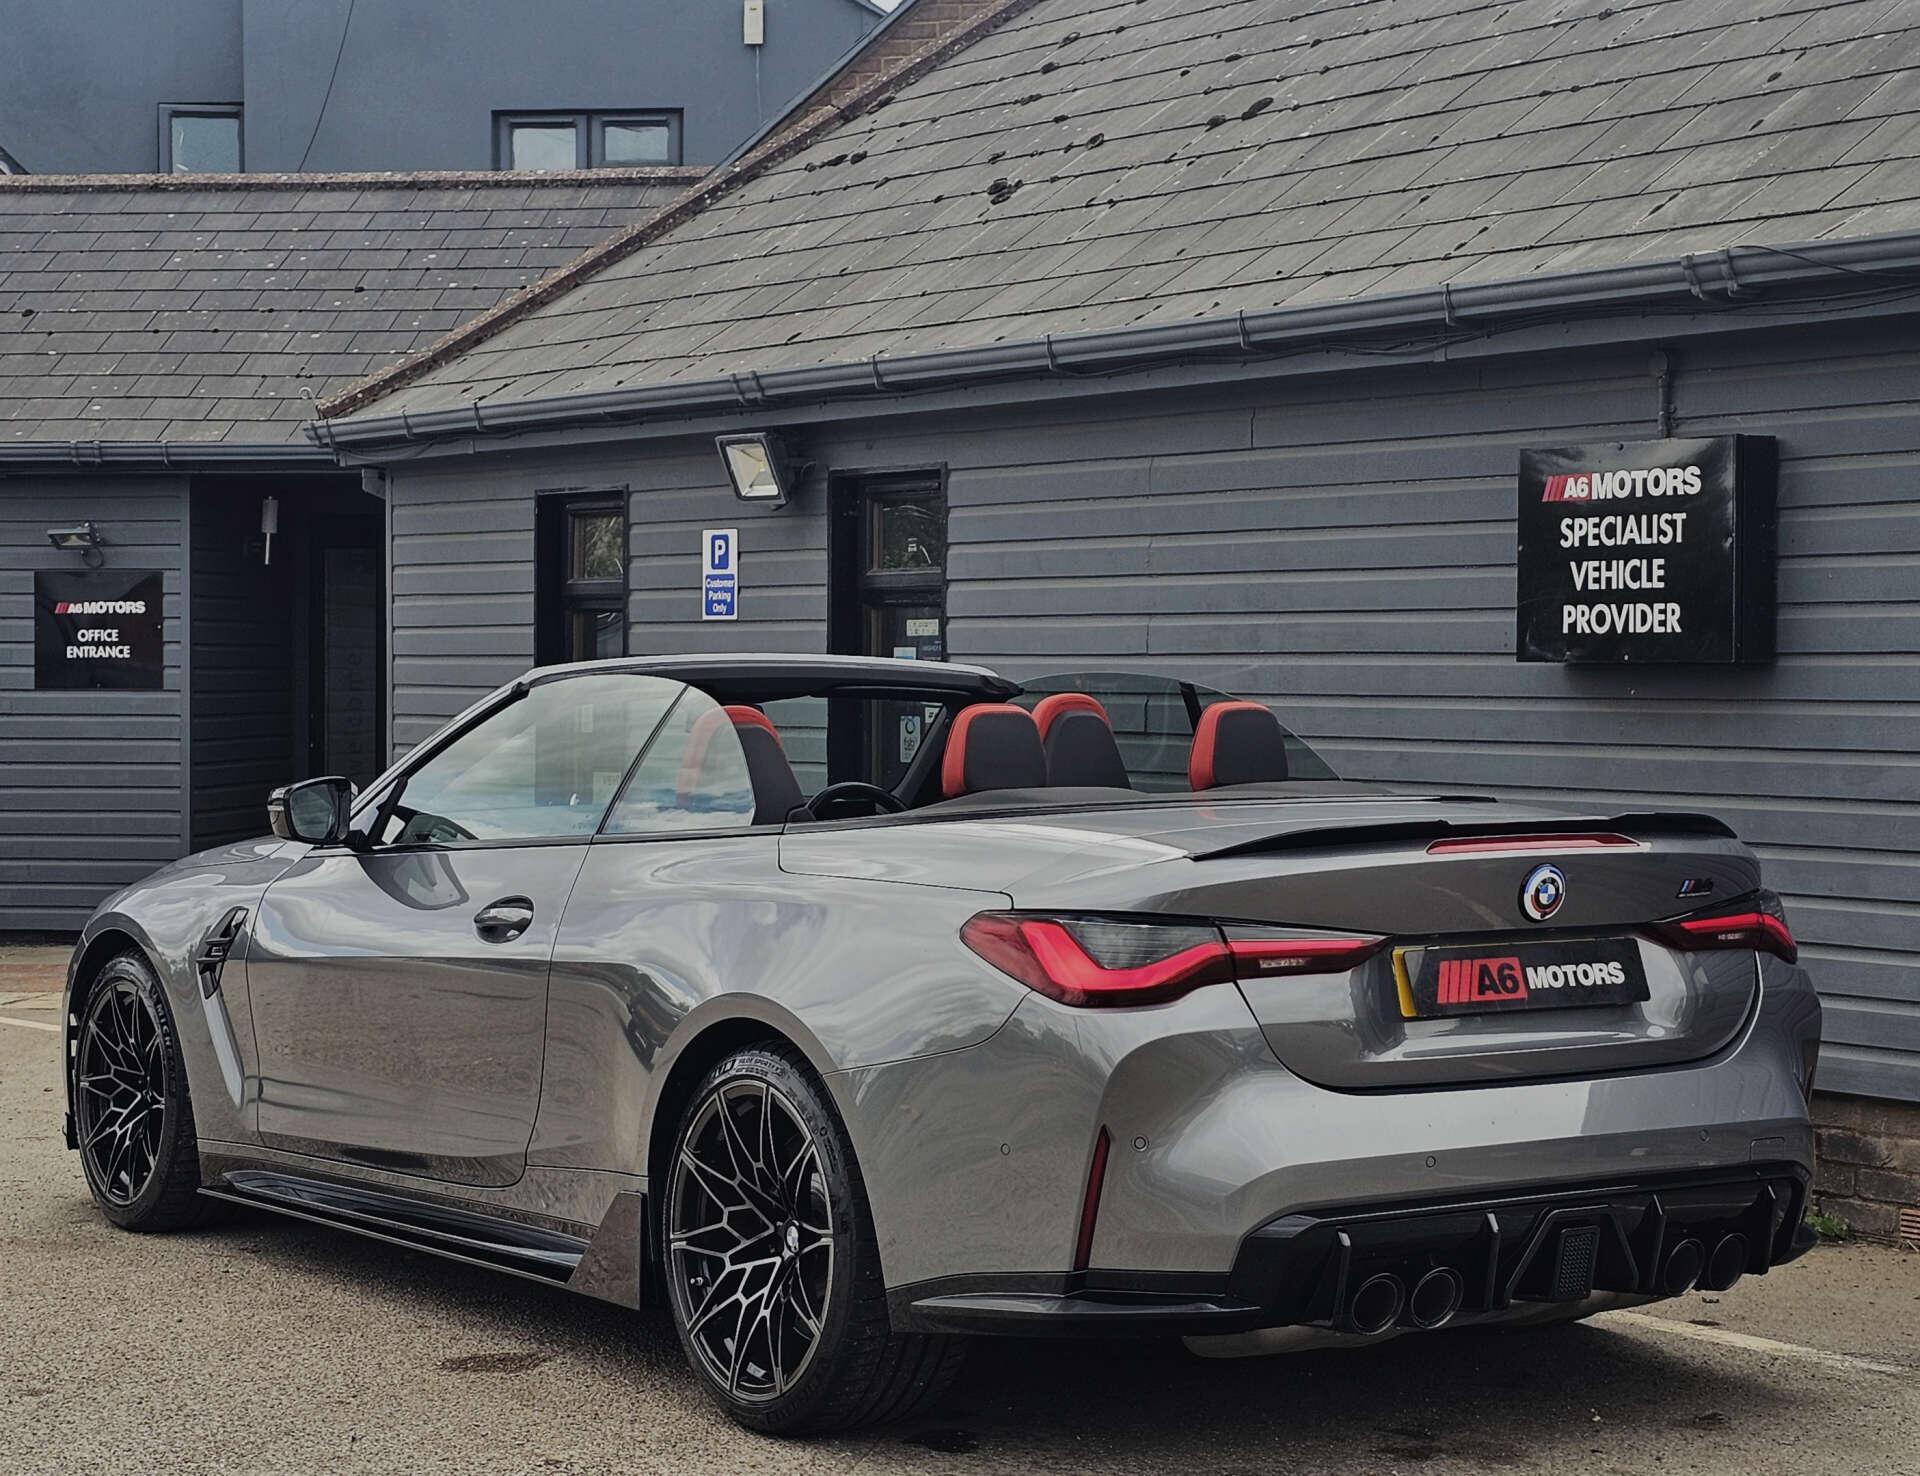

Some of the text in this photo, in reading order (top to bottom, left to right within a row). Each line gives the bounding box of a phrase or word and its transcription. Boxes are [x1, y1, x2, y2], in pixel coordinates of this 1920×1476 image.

[1564, 466, 1701, 499] A6 MOTORS
[1560, 513, 1686, 548] SPECIALIST
[715, 540, 726, 564] P
[706, 579, 734, 588] Customer
[1569, 558, 1665, 591] VEHICLE
[708, 591, 731, 602] Parking
[67, 601, 146, 614] A6 MOTORS
[712, 603, 727, 614] Only
[1562, 602, 1682, 634] PROVIDER
[77, 629, 119, 642] OFFICE
[67, 646, 130, 658] ENTRANCE
[1477, 961, 1625, 997] A6 MOTORS
